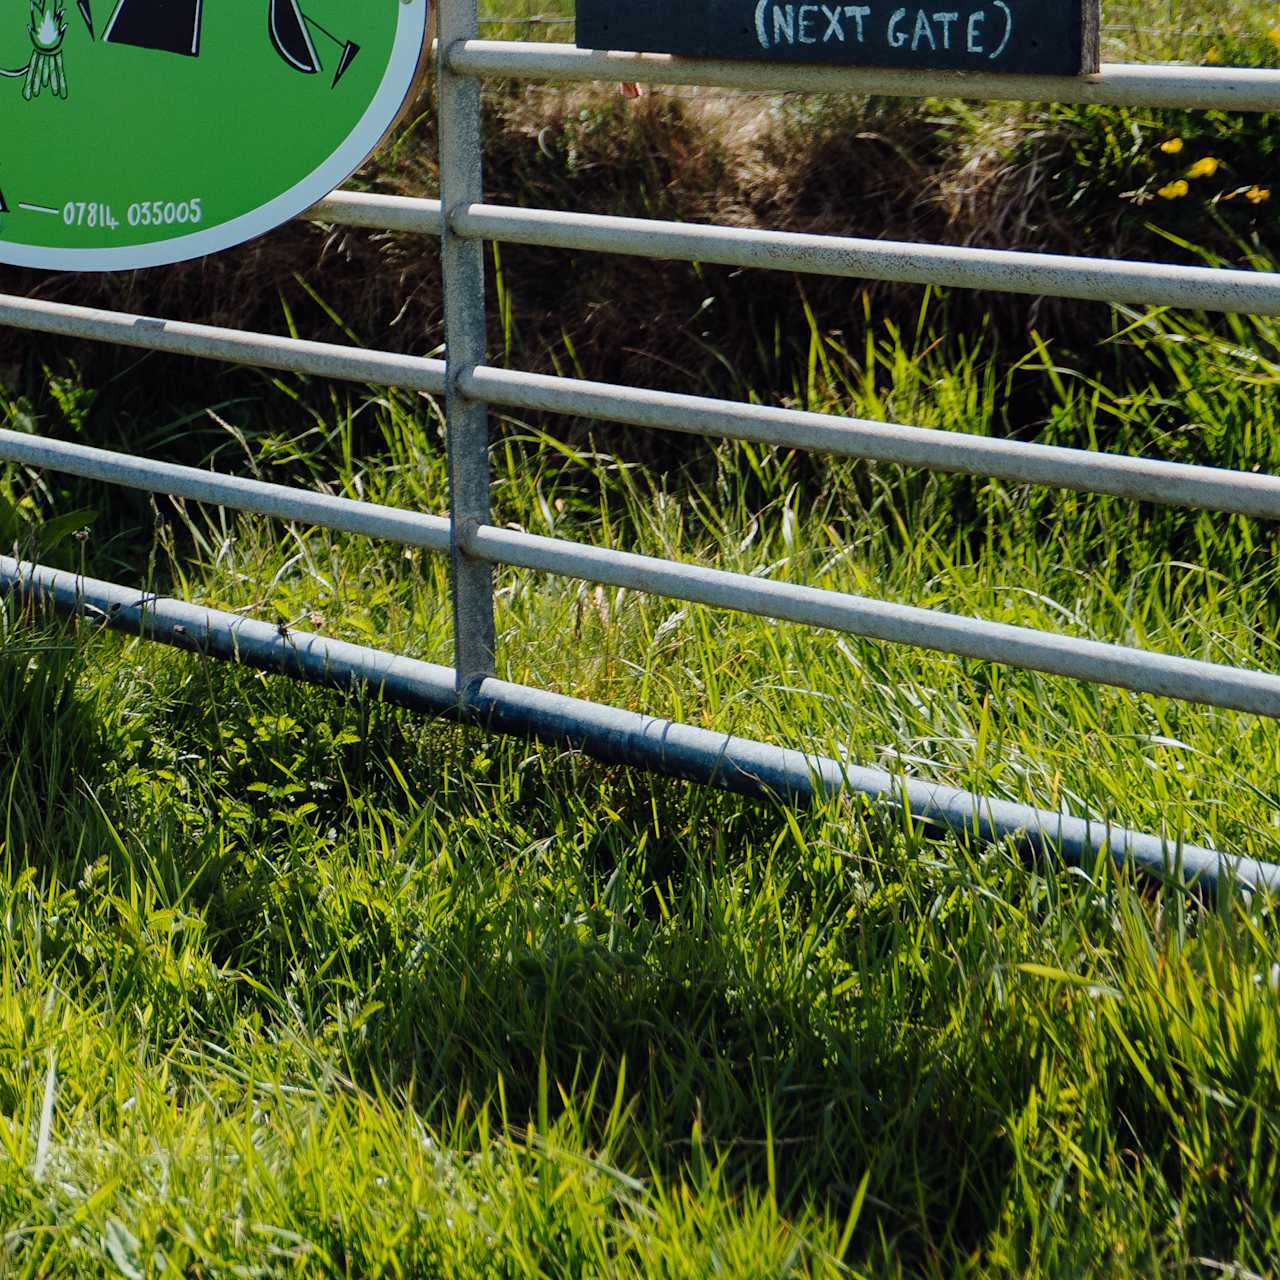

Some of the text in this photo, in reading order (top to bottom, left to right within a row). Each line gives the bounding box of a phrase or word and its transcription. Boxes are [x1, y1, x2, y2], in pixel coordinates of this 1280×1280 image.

[886, 0, 1013, 60] GATE)
[63, 199, 203, 230] 07814 035005
